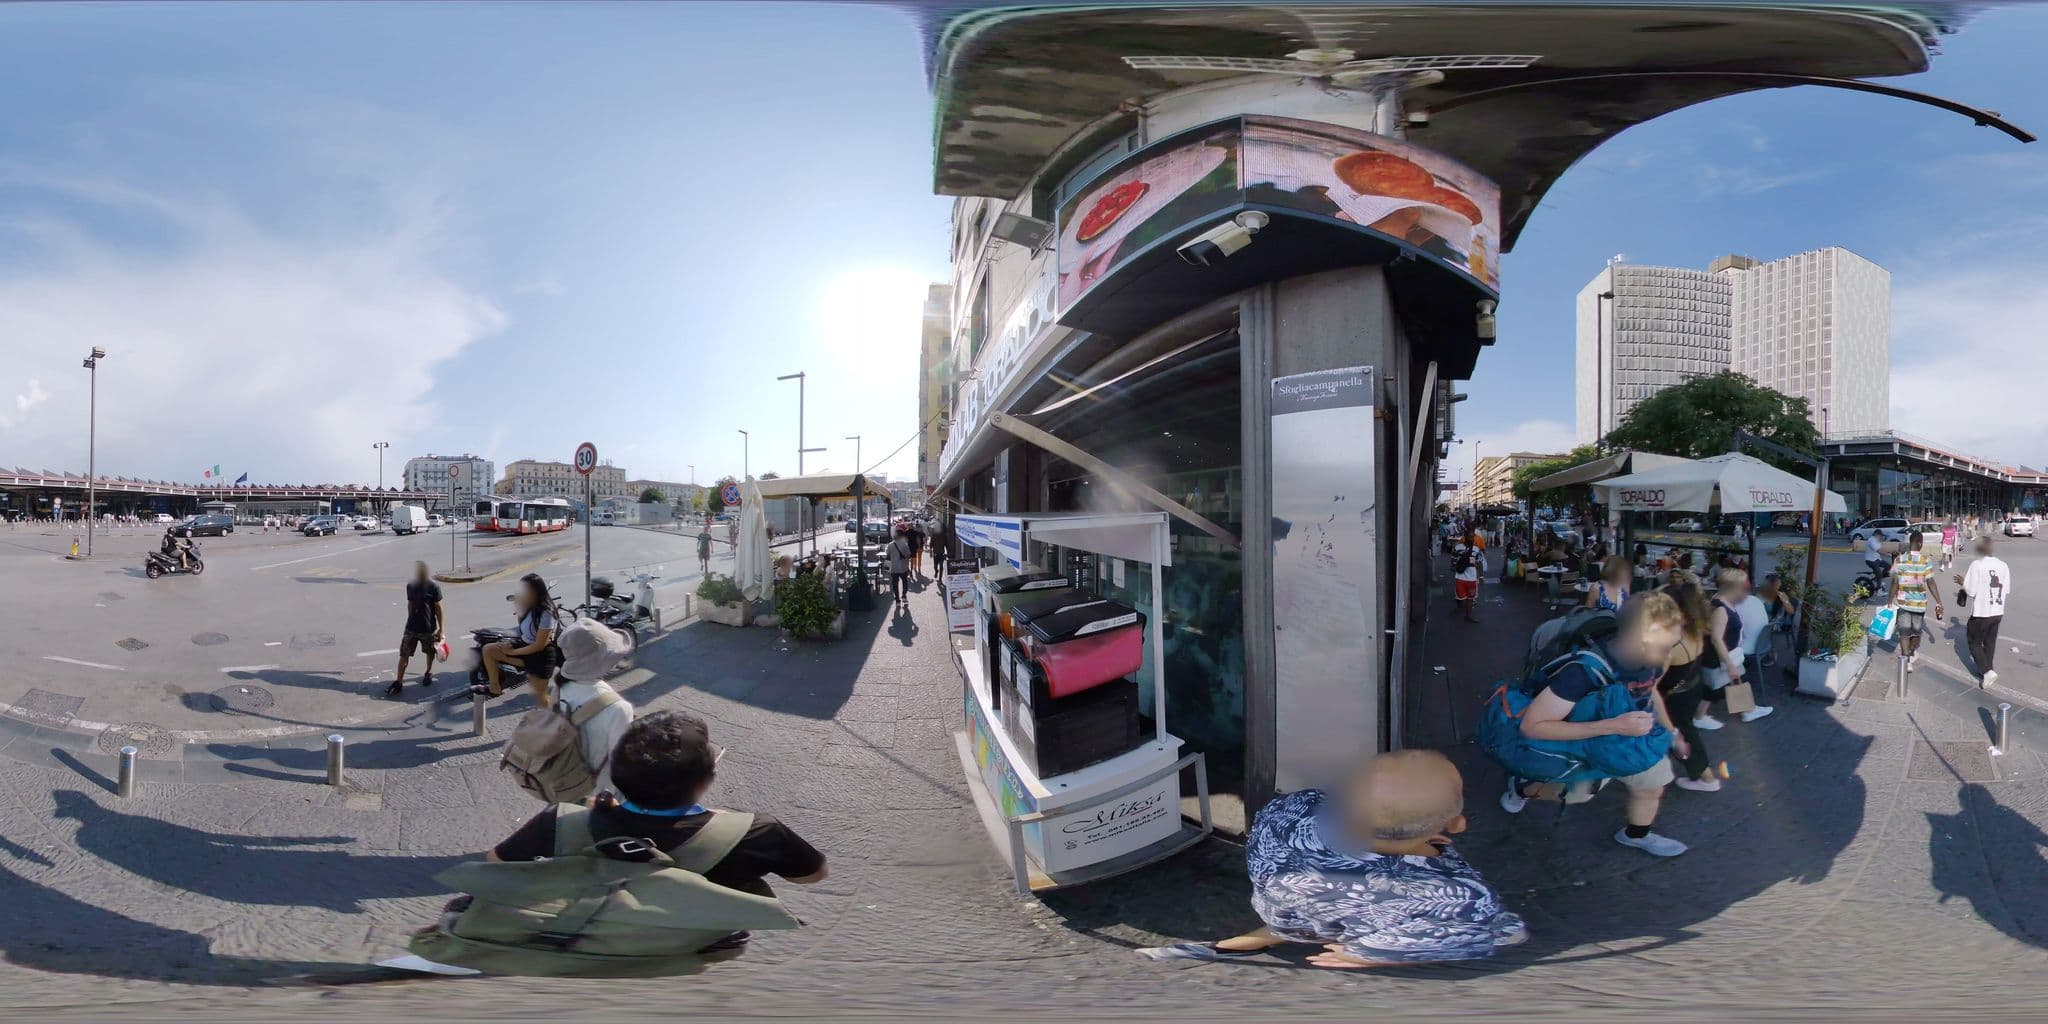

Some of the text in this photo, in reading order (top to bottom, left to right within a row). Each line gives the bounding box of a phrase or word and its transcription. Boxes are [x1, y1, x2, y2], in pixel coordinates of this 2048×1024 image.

[1279, 377, 1362, 395] Sfogliacampanella
[579, 450, 592, 467] 30
[1619, 489, 1665, 503] TORALDO
[1749, 490, 1793, 504] TORALDO
